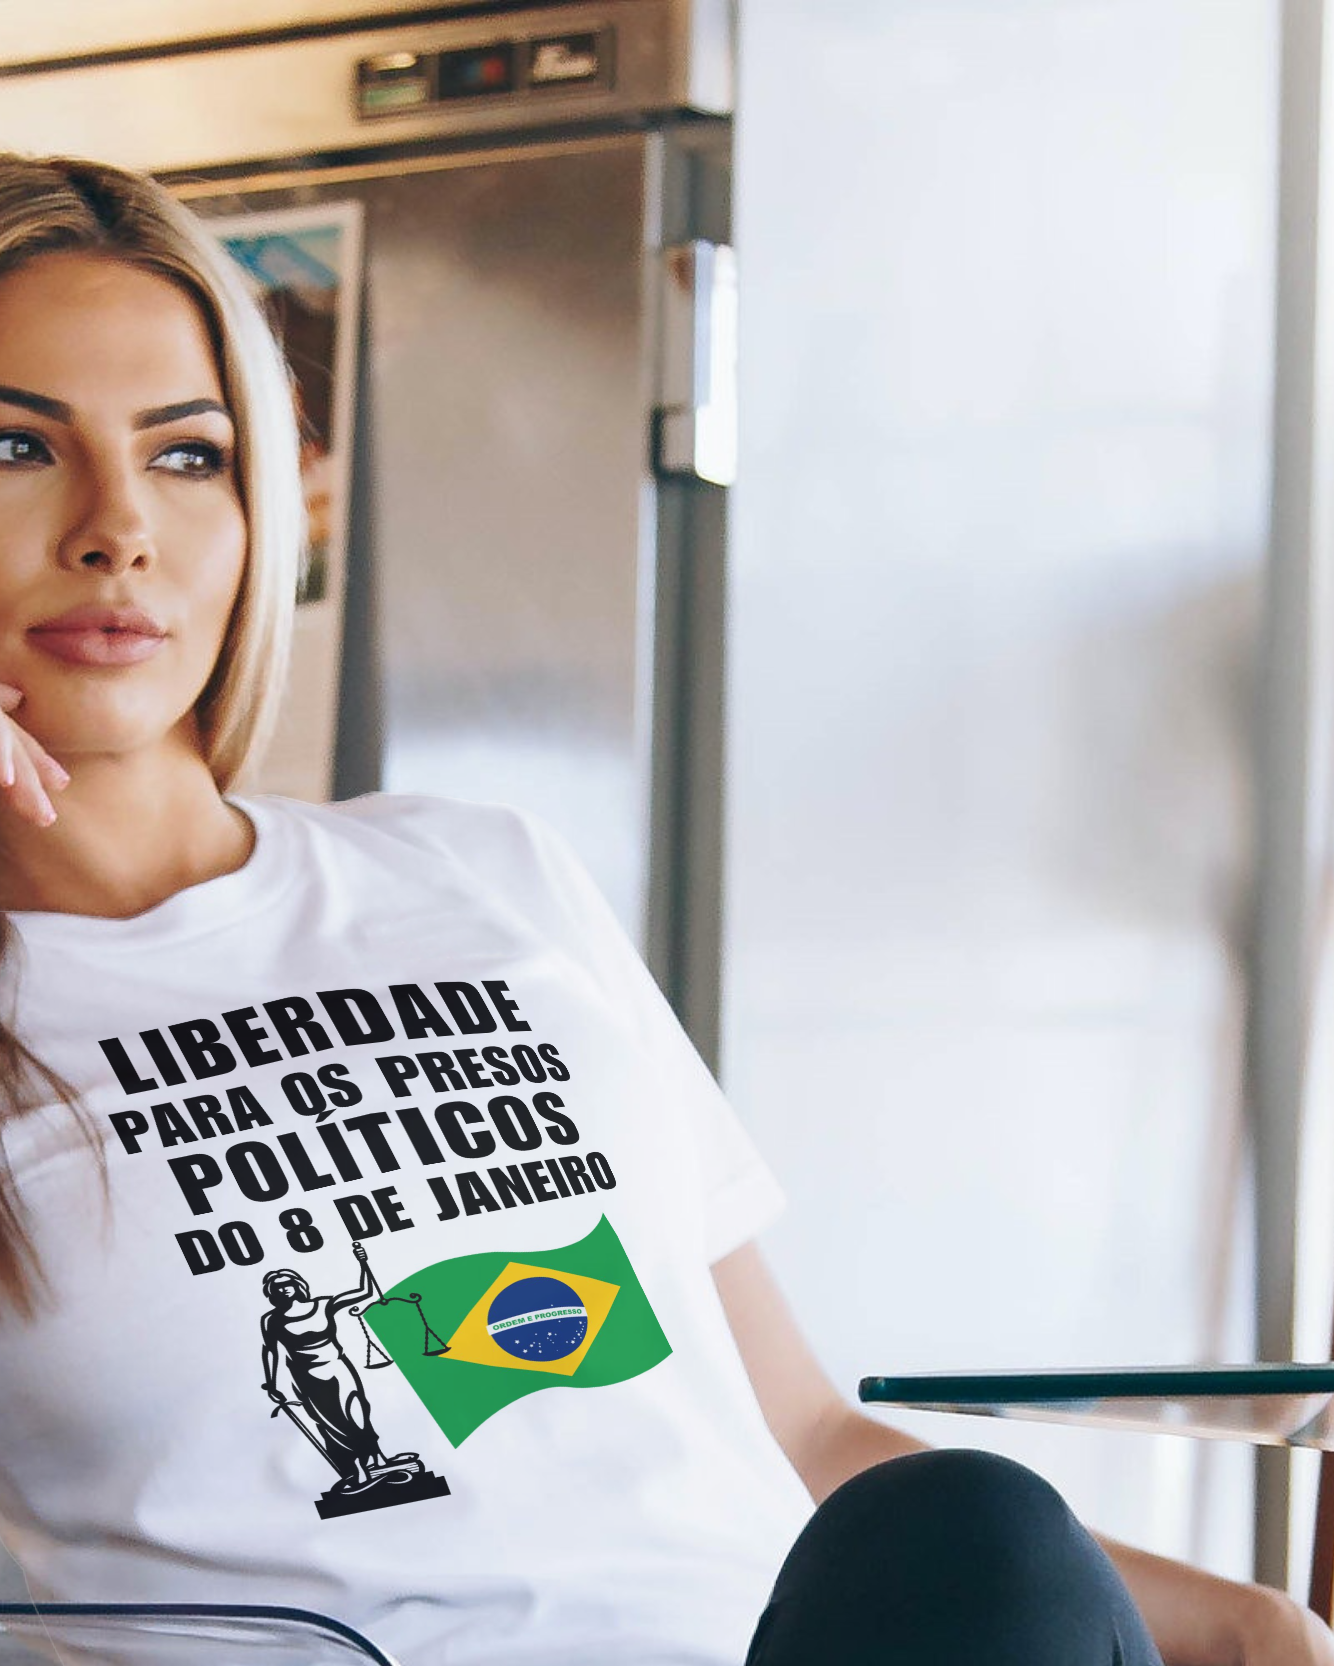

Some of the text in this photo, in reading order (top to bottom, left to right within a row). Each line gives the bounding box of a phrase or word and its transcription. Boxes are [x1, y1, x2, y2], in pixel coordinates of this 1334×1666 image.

[98, 980, 532, 1095] LIBERDADE
[108, 1044, 571, 1154] PARA OS PRESOS
[167, 1092, 580, 1216] POLÍTICOS
[174, 1151, 617, 1276] DO 8 DE JANEIRO
[492, 1317, 526, 1331] ORDEM
[534, 1308, 582, 1320] PROGRESSO
